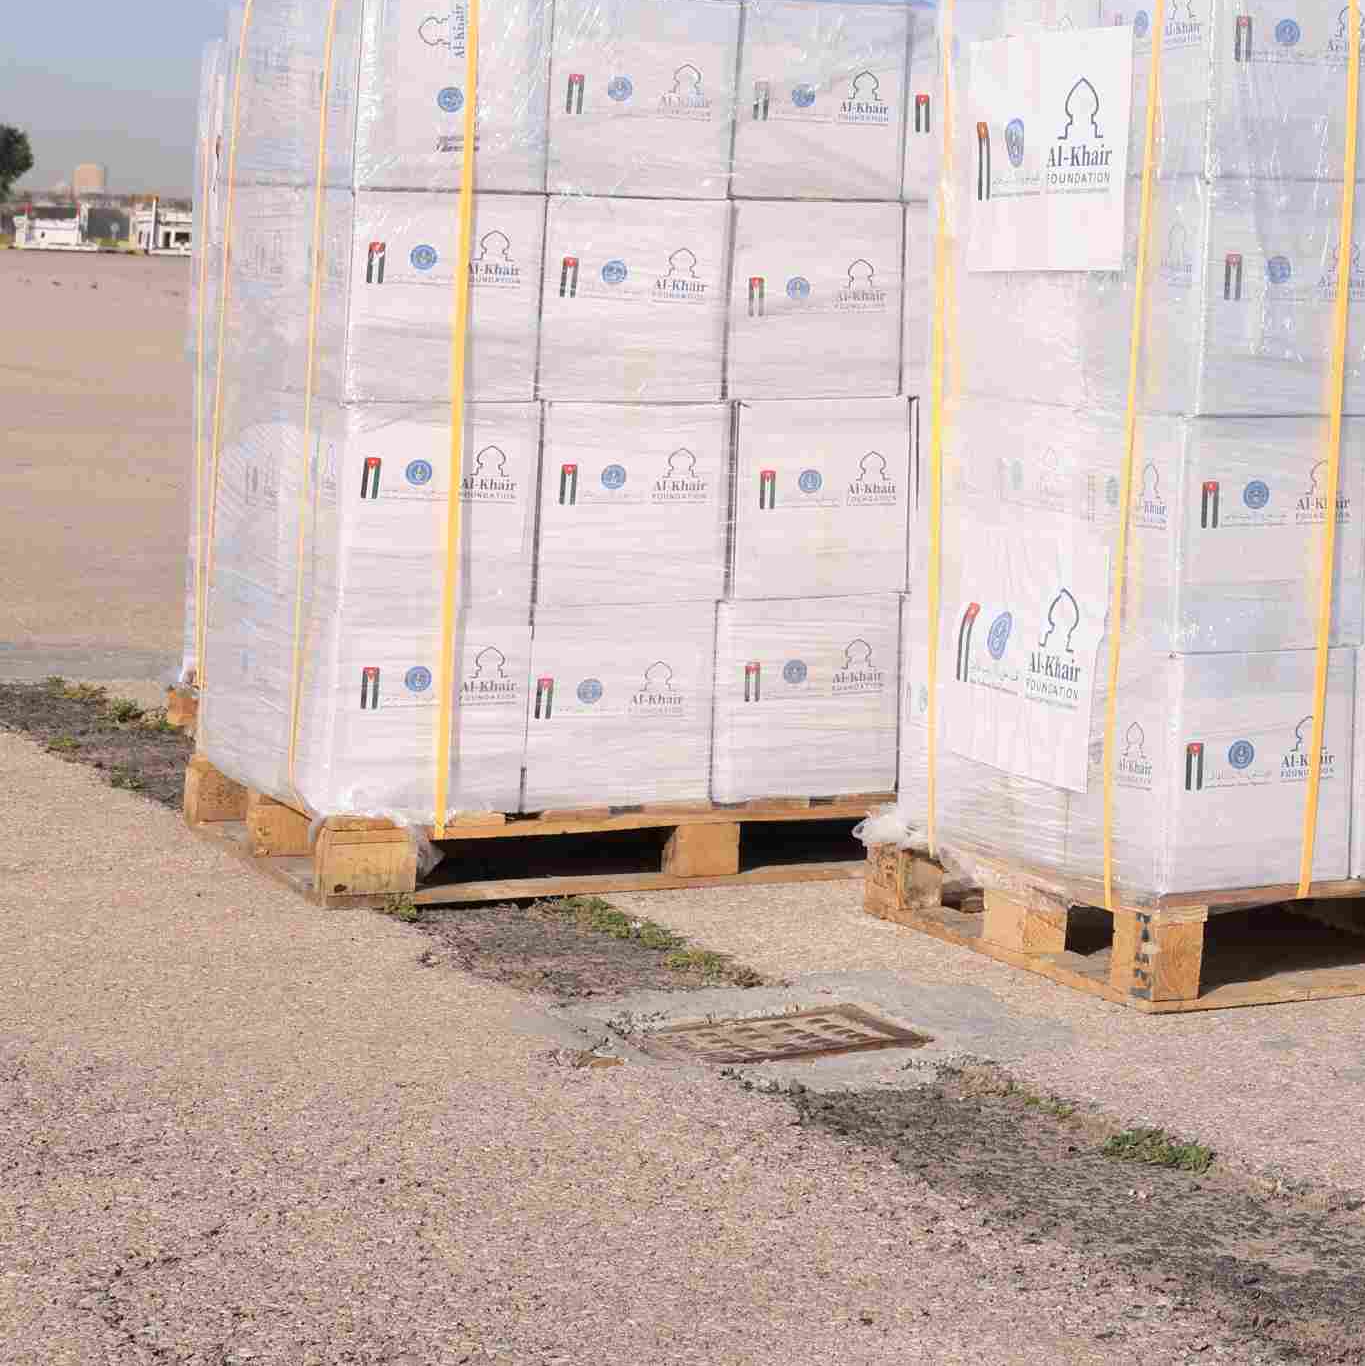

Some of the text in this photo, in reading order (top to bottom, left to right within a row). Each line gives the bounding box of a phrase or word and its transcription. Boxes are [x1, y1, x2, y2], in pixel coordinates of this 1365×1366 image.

[1047, 144, 1112, 167] Al-Khair
[1047, 171, 1111, 185] FOUNDATION
[462, 477, 517, 491] Al-Khair
[655, 480, 707, 491] Al-Khair
[1029, 651, 1081, 683] Al-Khair
[831, 671, 884, 685] Al-Khair
[462, 680, 517, 692] Al-Khair
[1026, 679, 1079, 699] FOUNDATION
